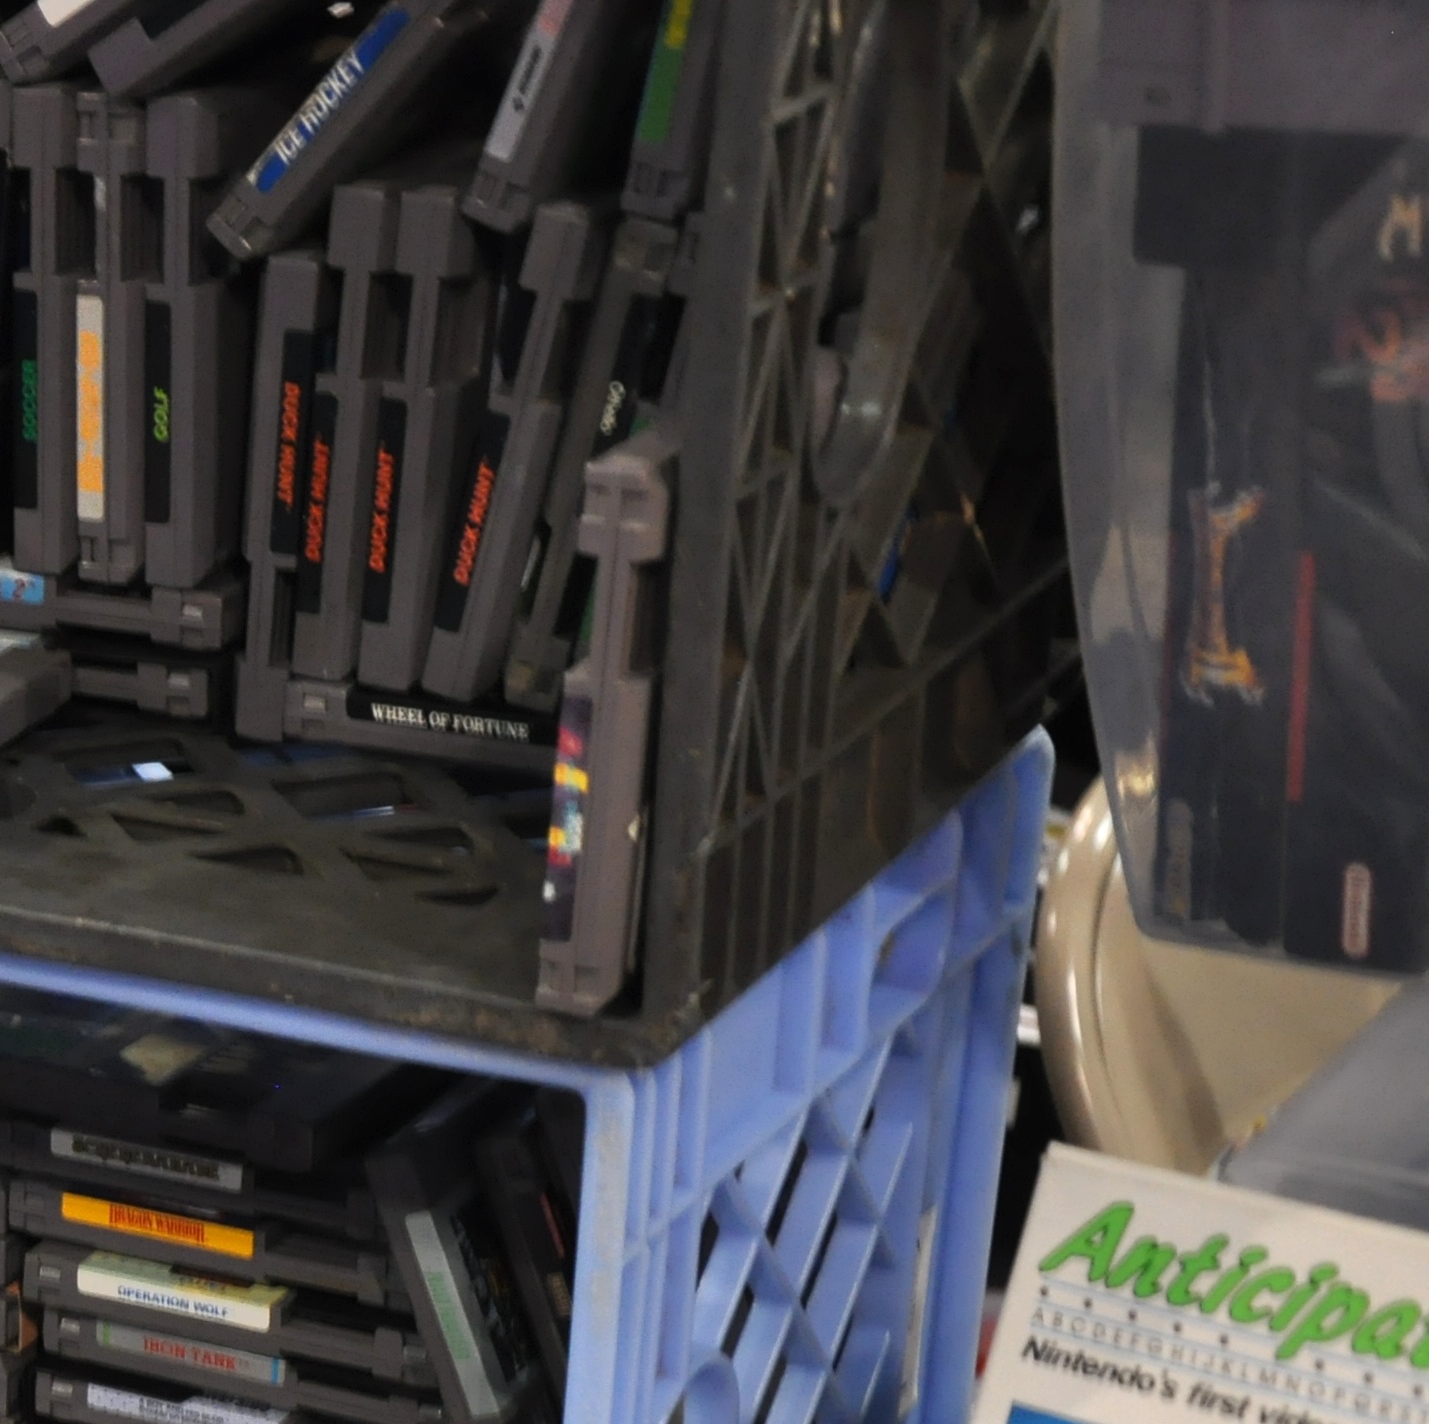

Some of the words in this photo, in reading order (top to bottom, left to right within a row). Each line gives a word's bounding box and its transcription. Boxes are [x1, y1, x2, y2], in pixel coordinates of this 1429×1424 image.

[22, 359, 38, 442] SOCCER
[153, 386, 171, 443] GOLF
[282, 381, 301, 442] DUCK
[310, 438, 330, 500] HUNT
[375, 448, 394, 511] HUNT
[305, 503, 325, 563] DUCK
[369, 512, 389, 573] DUCK
[453, 525, 482, 587] DUCK
[468, 461, 496, 524] HUNT
[371, 703, 427, 725] WHEEL
[429, 711, 451, 727] OF
[453, 713, 529, 741] FORTUNE
[108, 1203, 154, 1230] DRAGON
[117, 1284, 190, 1311] OPERATION
[194, 1300, 229, 1318] WOLF
[143, 1336, 186, 1360] IRON
[192, 1347, 237, 1371] TANK
[1021, 1335, 1180, 1401] Nintendo's
[1187, 1380, 1252, 1419] first
